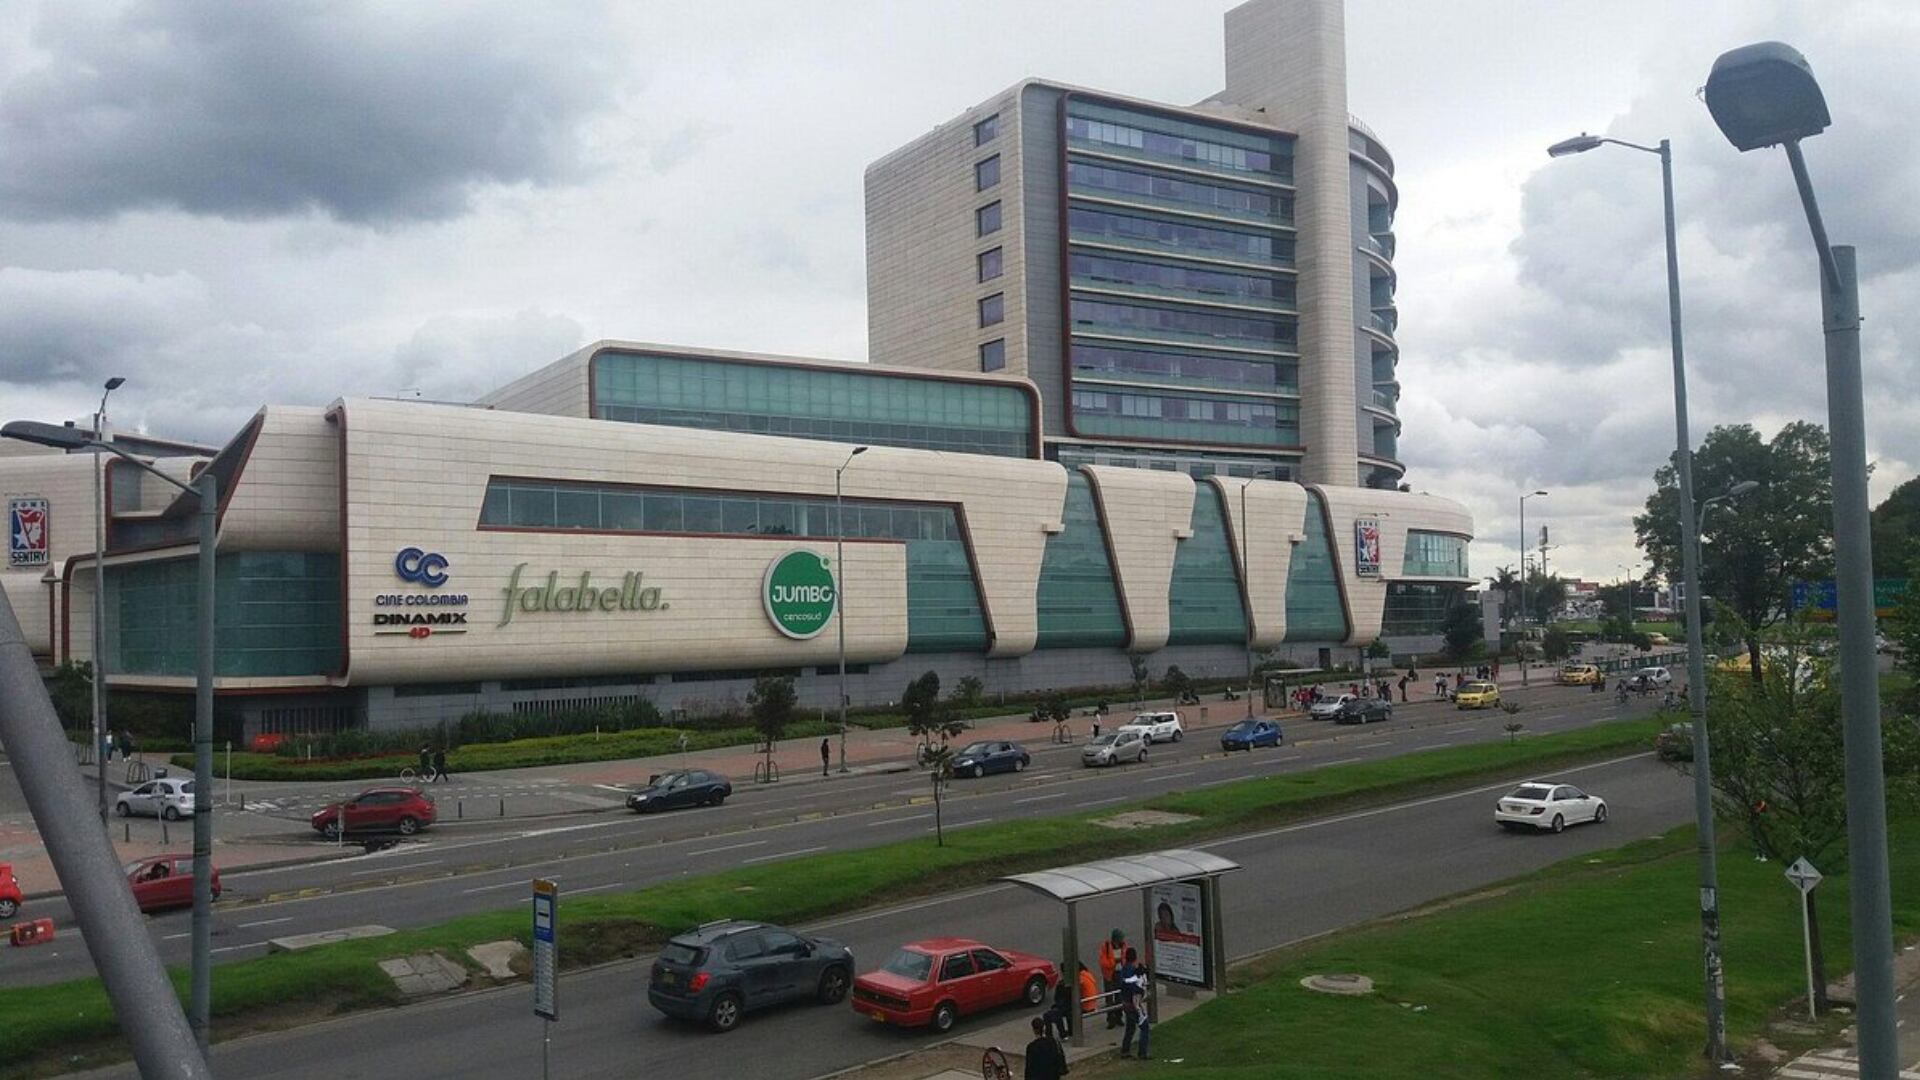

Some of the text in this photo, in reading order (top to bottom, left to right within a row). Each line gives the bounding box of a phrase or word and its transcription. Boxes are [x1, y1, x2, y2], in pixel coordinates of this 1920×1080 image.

[11, 551, 46, 563] SENTRY
[375, 594, 469, 606] CINE COLOMBIA
[772, 585, 833, 603] JUMBO
[373, 613, 468, 625] DINAMIX
[408, 627, 431, 639] 4D
